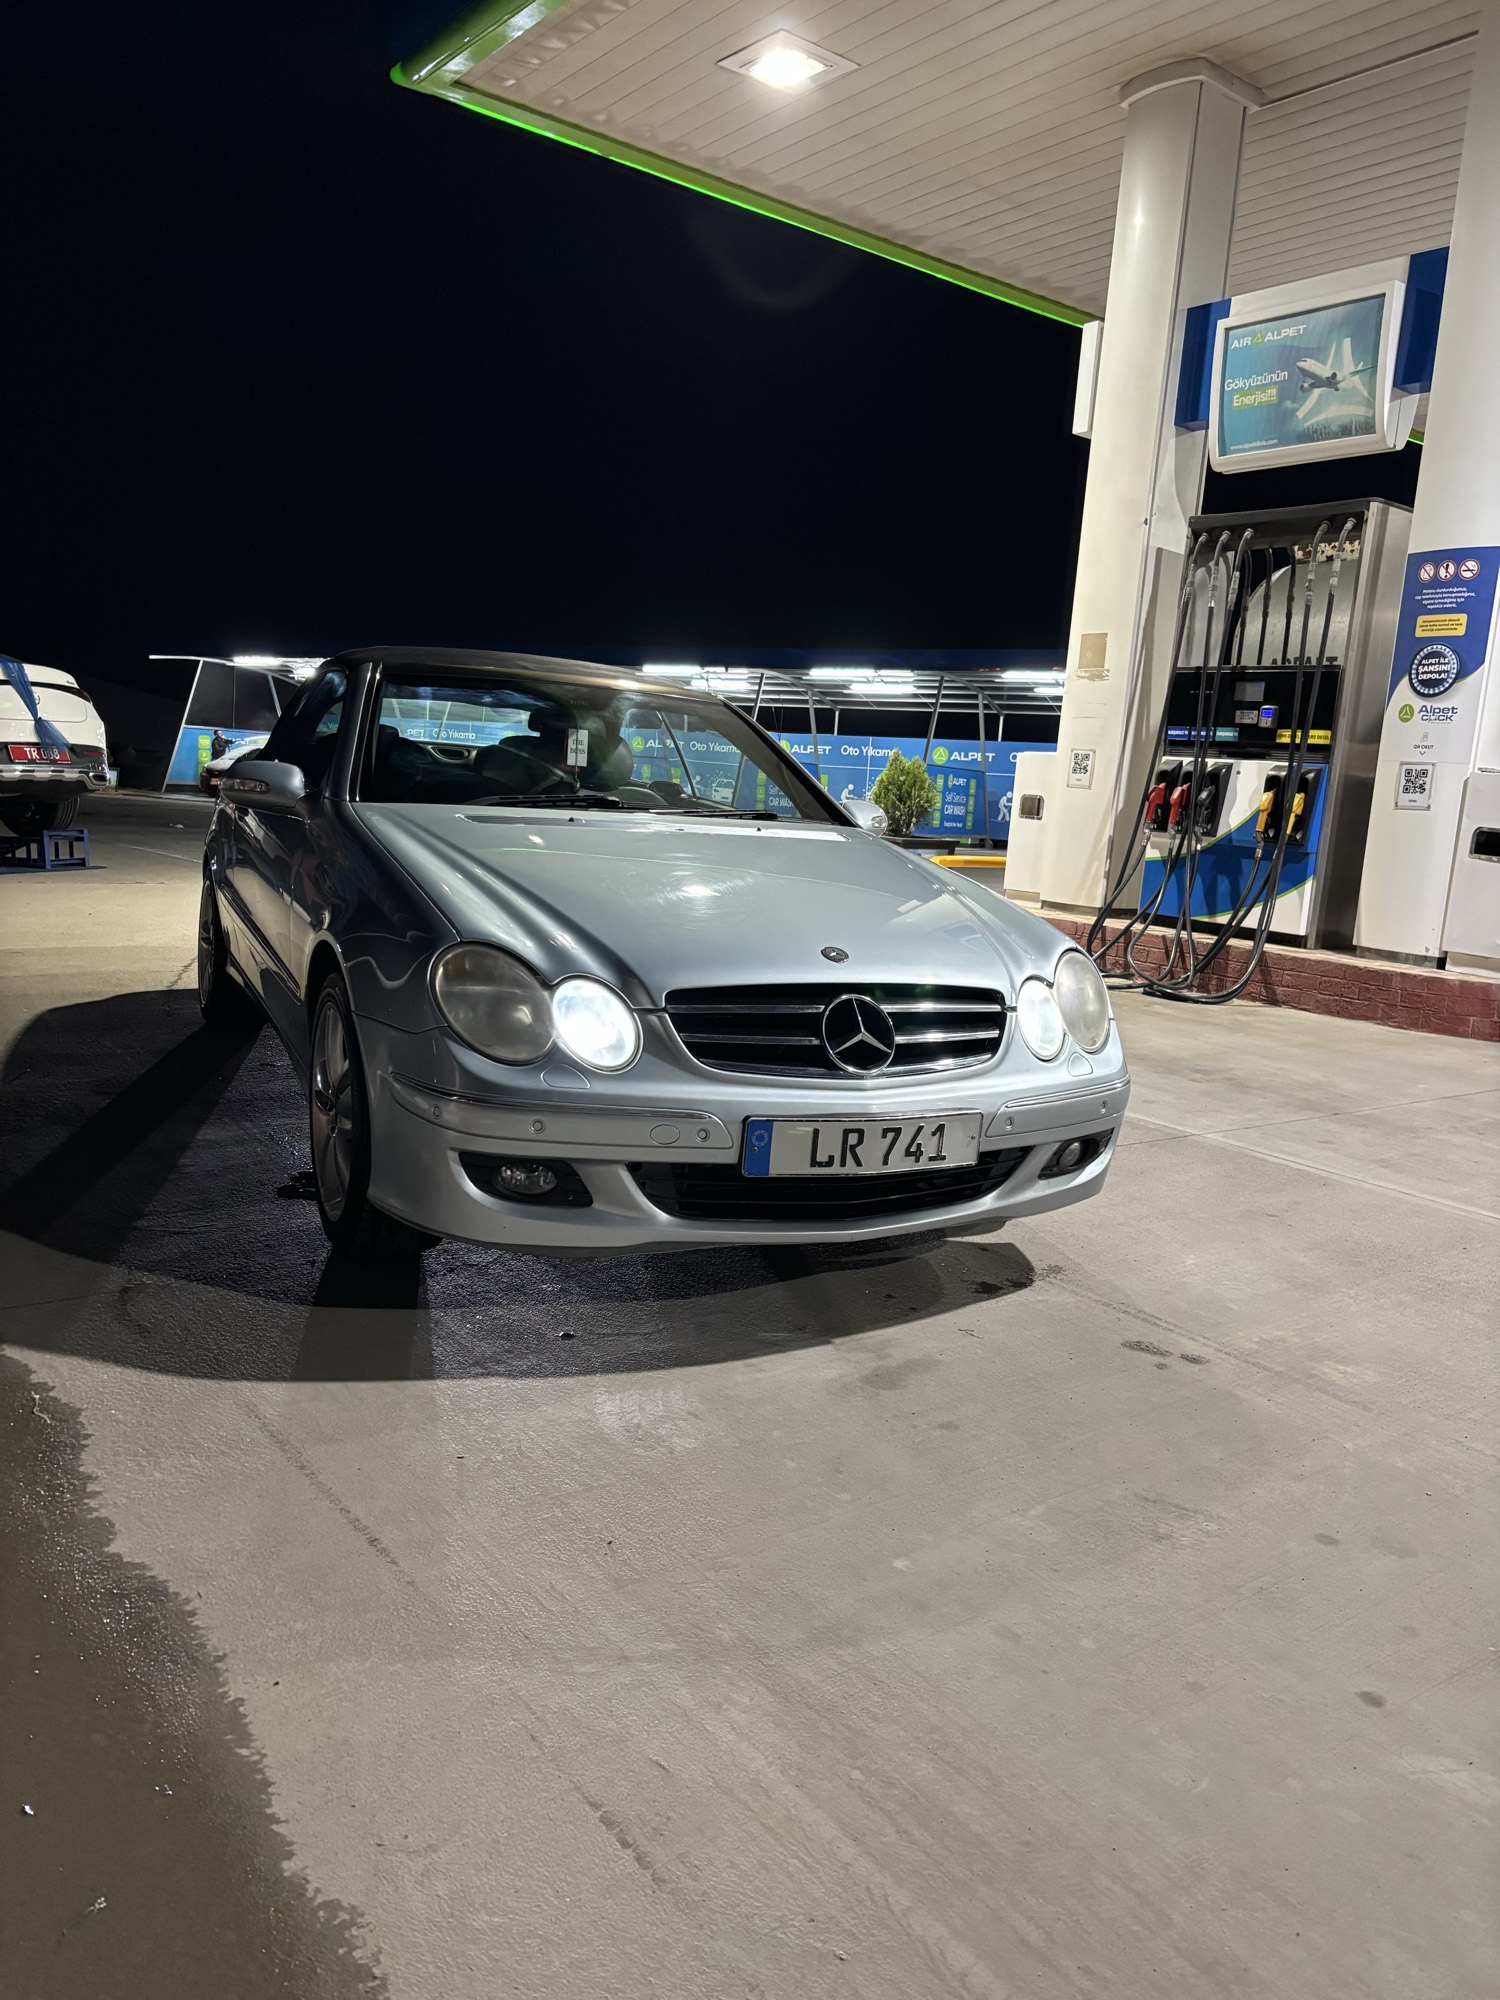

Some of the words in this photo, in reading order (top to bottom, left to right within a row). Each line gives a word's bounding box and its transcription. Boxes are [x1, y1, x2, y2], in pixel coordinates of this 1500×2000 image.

[1231, 336, 1252, 349] AIR
[1264, 324, 1307, 342] ALPET
[1224, 370, 1288, 390] Gökyüzünün
[1233, 388, 1277, 406] Enerjisi!!!
[1418, 664, 1450, 674] ŞANSINI
[1418, 704, 1458, 716] Alpet
[690, 741, 707, 751] Oto
[840, 744, 859, 756] Oto
[23, 747, 40, 760] TR
[953, 777, 967, 786] ALPET
[769, 797, 779, 806] CAR
[953, 792, 966, 803] Service
[944, 804, 953, 815] CAR
[953, 805, 966, 816] WASH
[809, 1127, 865, 1168] LR
[881, 1121, 947, 1167] 741
